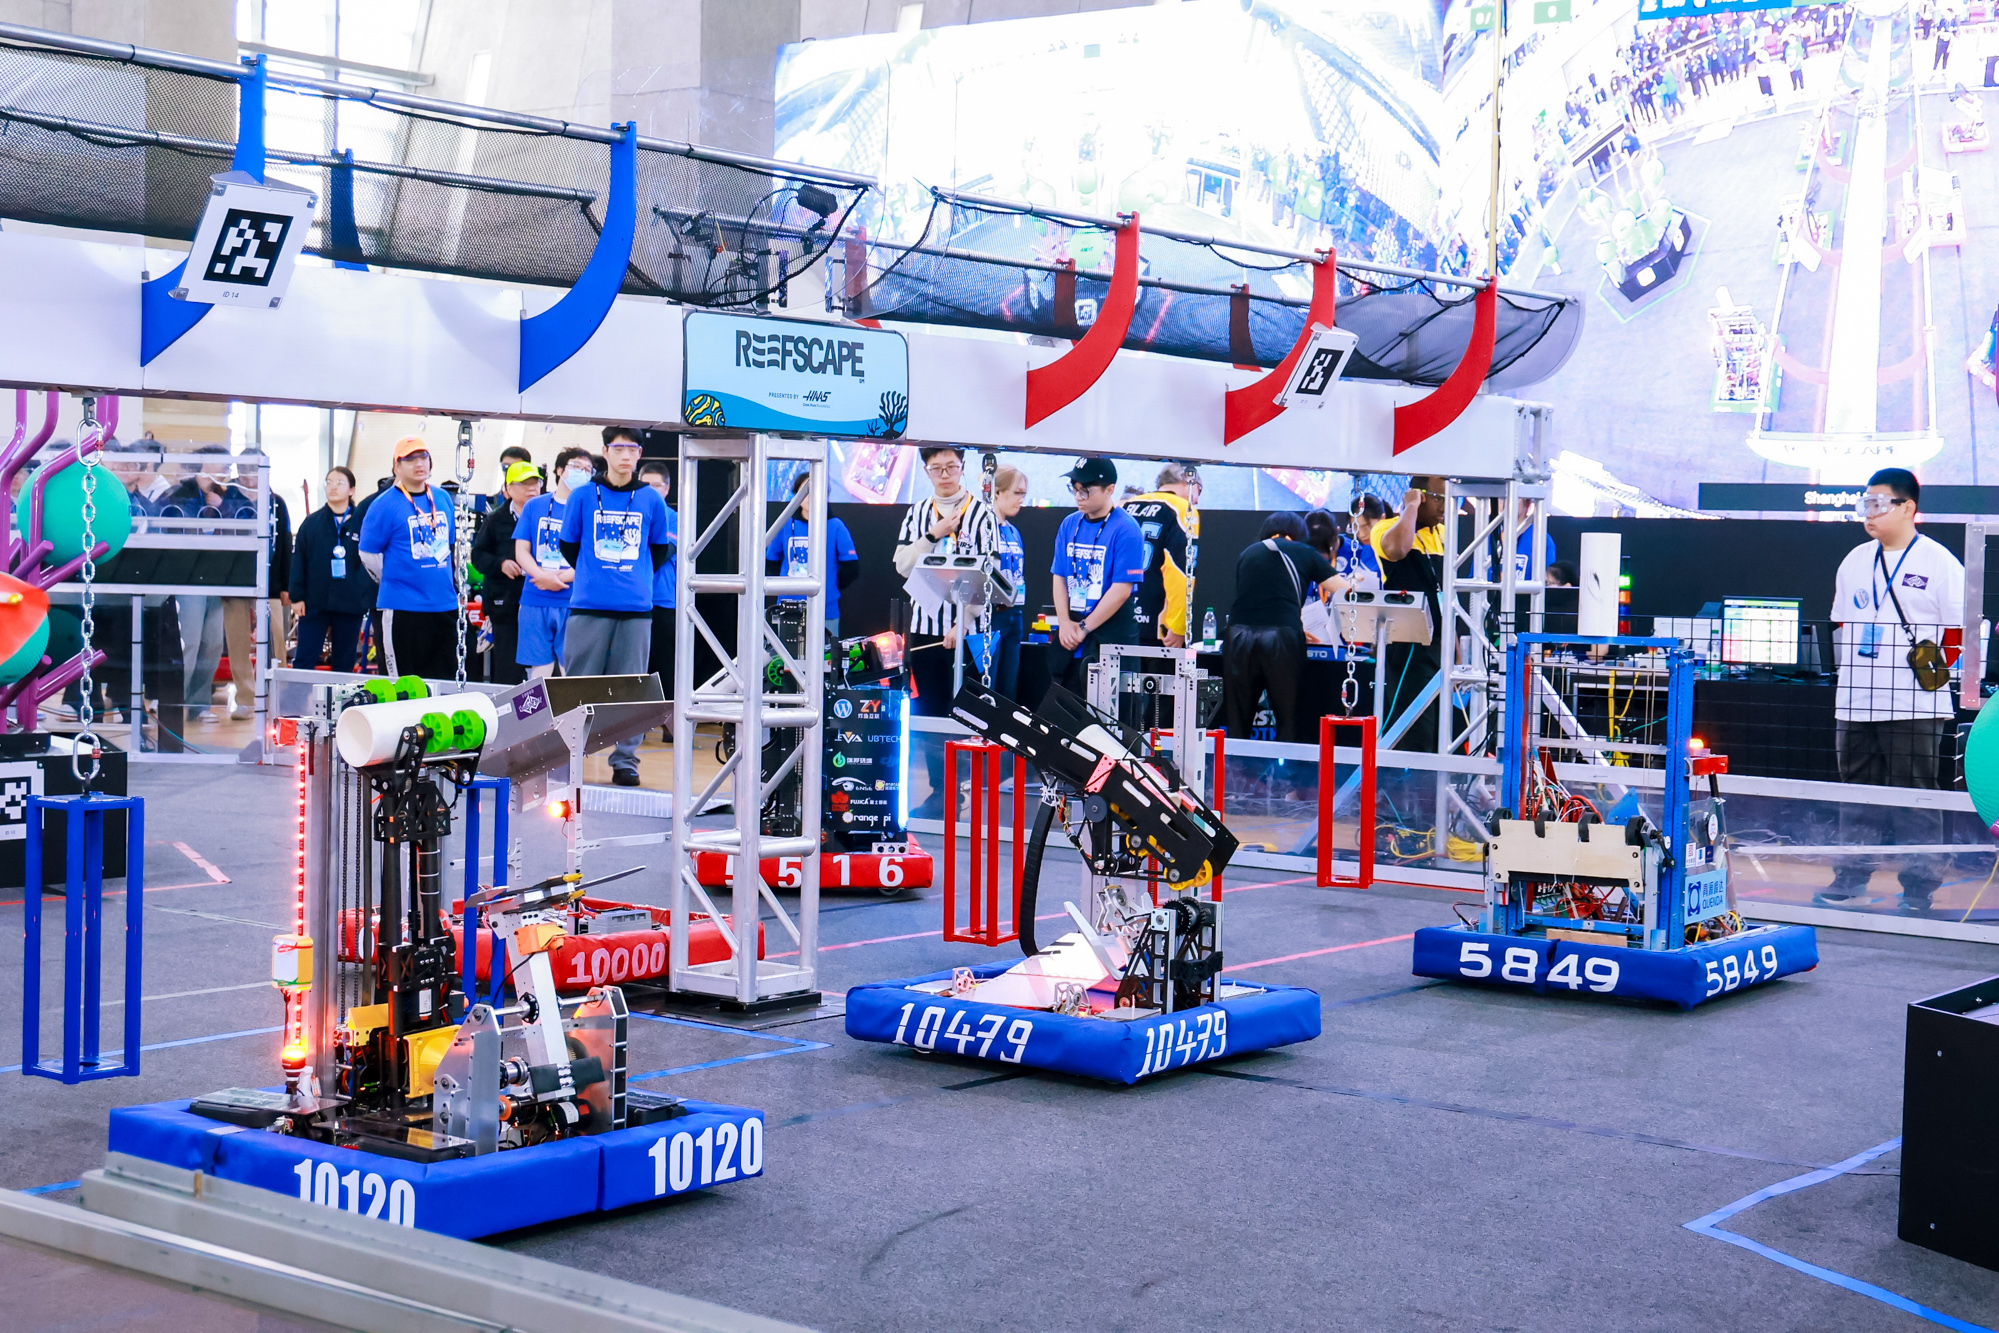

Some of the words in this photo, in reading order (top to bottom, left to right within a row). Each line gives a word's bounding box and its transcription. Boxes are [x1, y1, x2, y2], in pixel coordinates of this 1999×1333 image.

[735, 330, 865, 377] REEFSCAPE
[768, 391, 793, 399] PRESENTED
[802, 390, 832, 402] HAAS
[859, 699, 882, 713] ZY
[1702, 895, 1724, 910] QUENDA
[566, 942, 666, 985] 10000
[1459, 941, 1620, 992] 5849
[1705, 944, 1778, 997] 5849
[892, 1002, 1034, 1064] 10479
[1135, 1010, 1227, 1078] 10479
[648, 1116, 763, 1196] 10120
[293, 1158, 416, 1229] 10120
